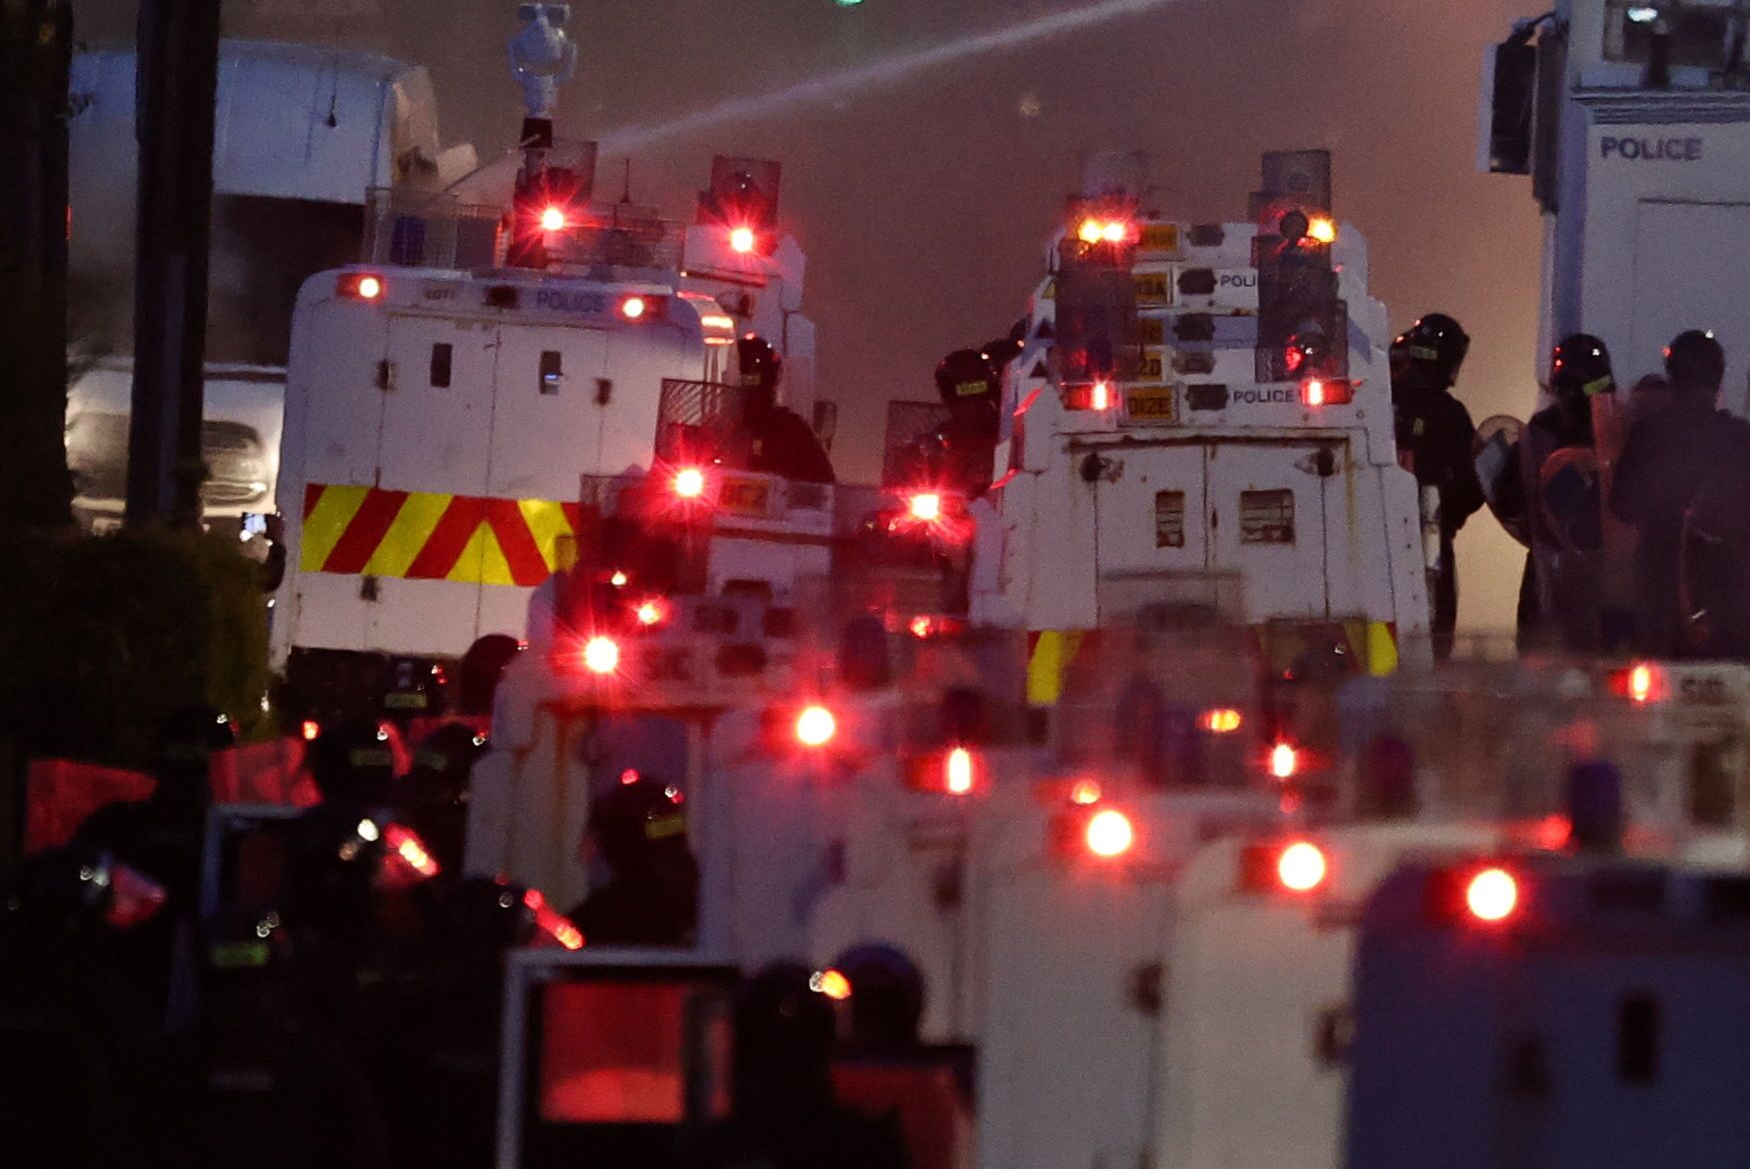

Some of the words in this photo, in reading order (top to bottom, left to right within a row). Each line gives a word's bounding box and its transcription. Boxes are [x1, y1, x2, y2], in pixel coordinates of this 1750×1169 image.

[1602, 136, 1702, 160] POLICE
[1220, 275, 1256, 287] POLI
[1233, 389, 1295, 403] POLICE
